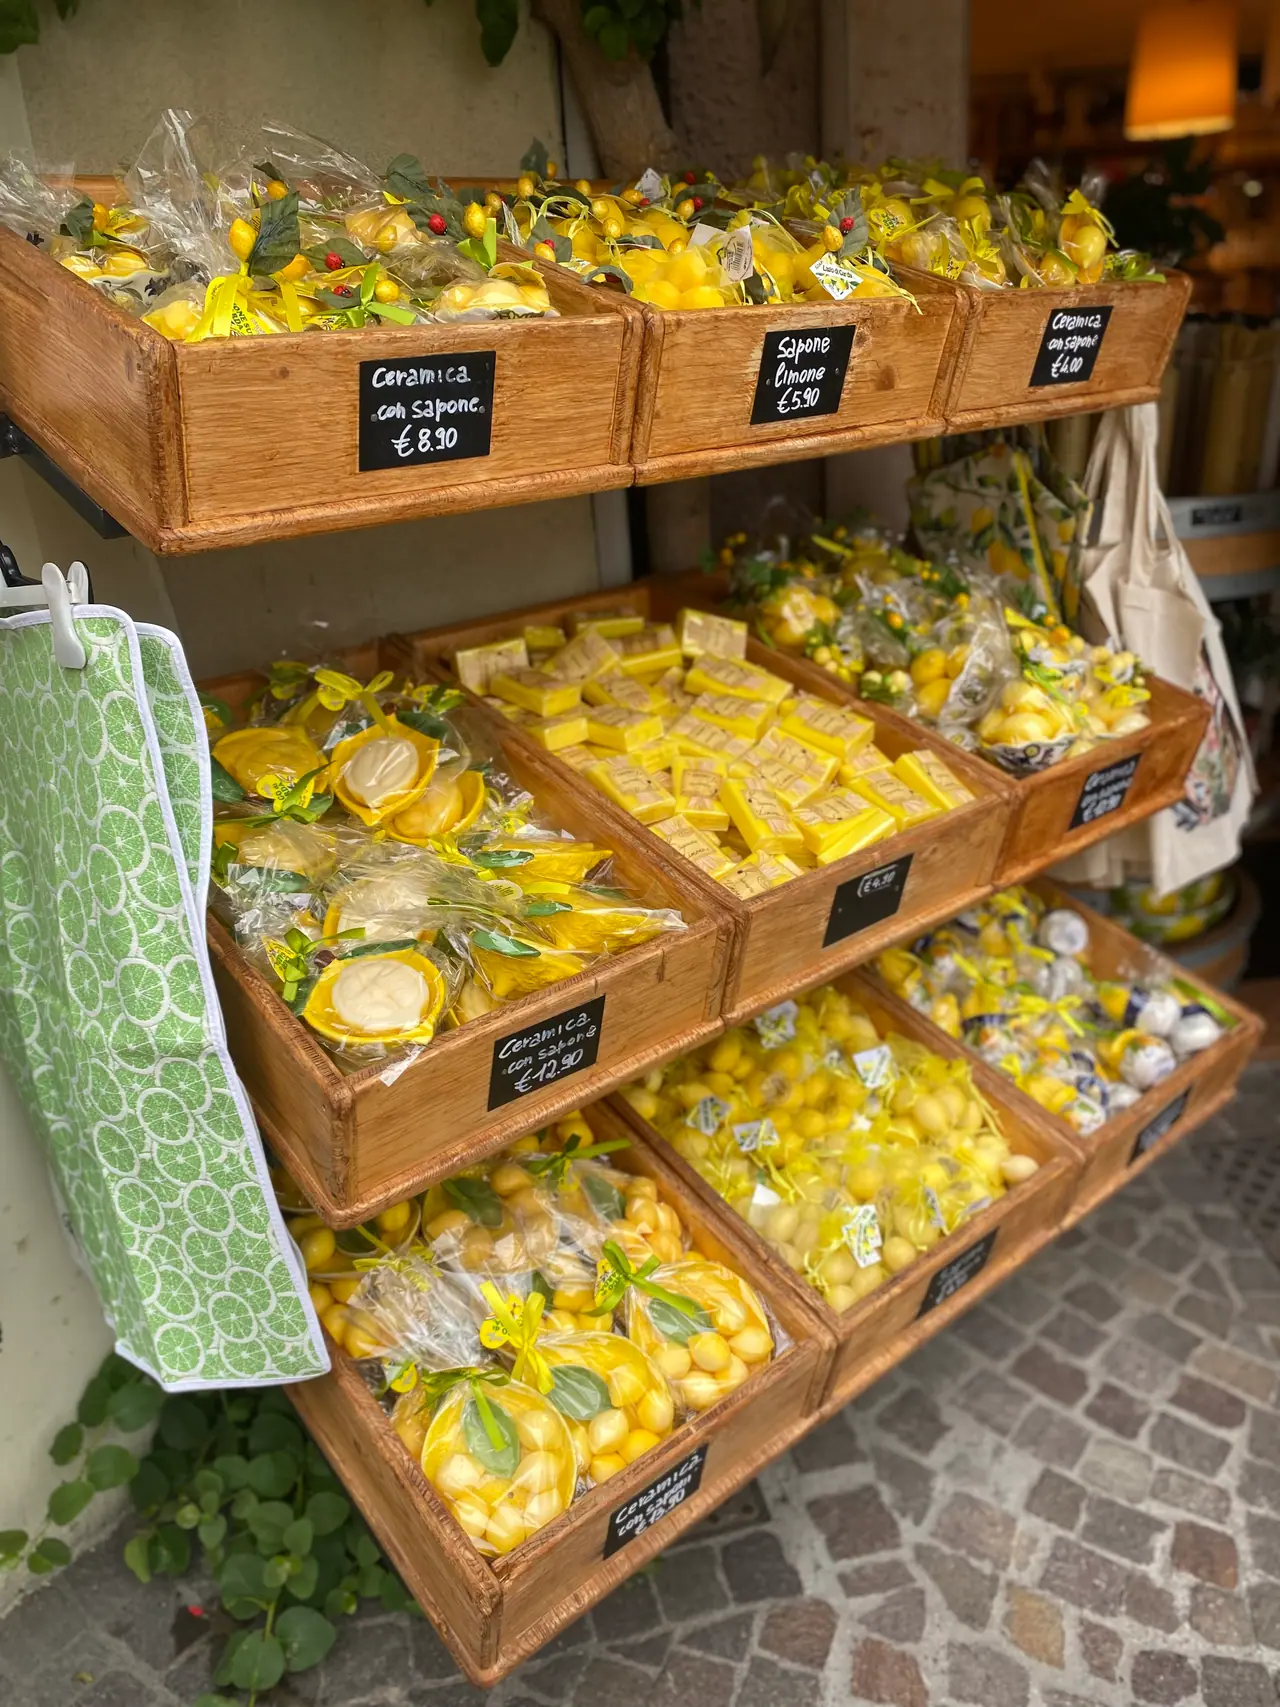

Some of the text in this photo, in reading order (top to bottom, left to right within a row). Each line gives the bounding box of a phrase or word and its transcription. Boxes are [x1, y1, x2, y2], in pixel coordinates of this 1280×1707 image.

[1051, 312, 1102, 330] Ceramica
[1047, 334, 1099, 352] con sapone
[371, 365, 471, 389] Ceramica
[376, 396, 480, 422] con sapone
[776, 387, 820, 413] €5.90
[498, 1012, 591, 1059] Ceramica
[507, 1025, 597, 1074] con sapone
[615, 1454, 703, 1525] Ceramica
[618, 1513, 644, 1537] con
